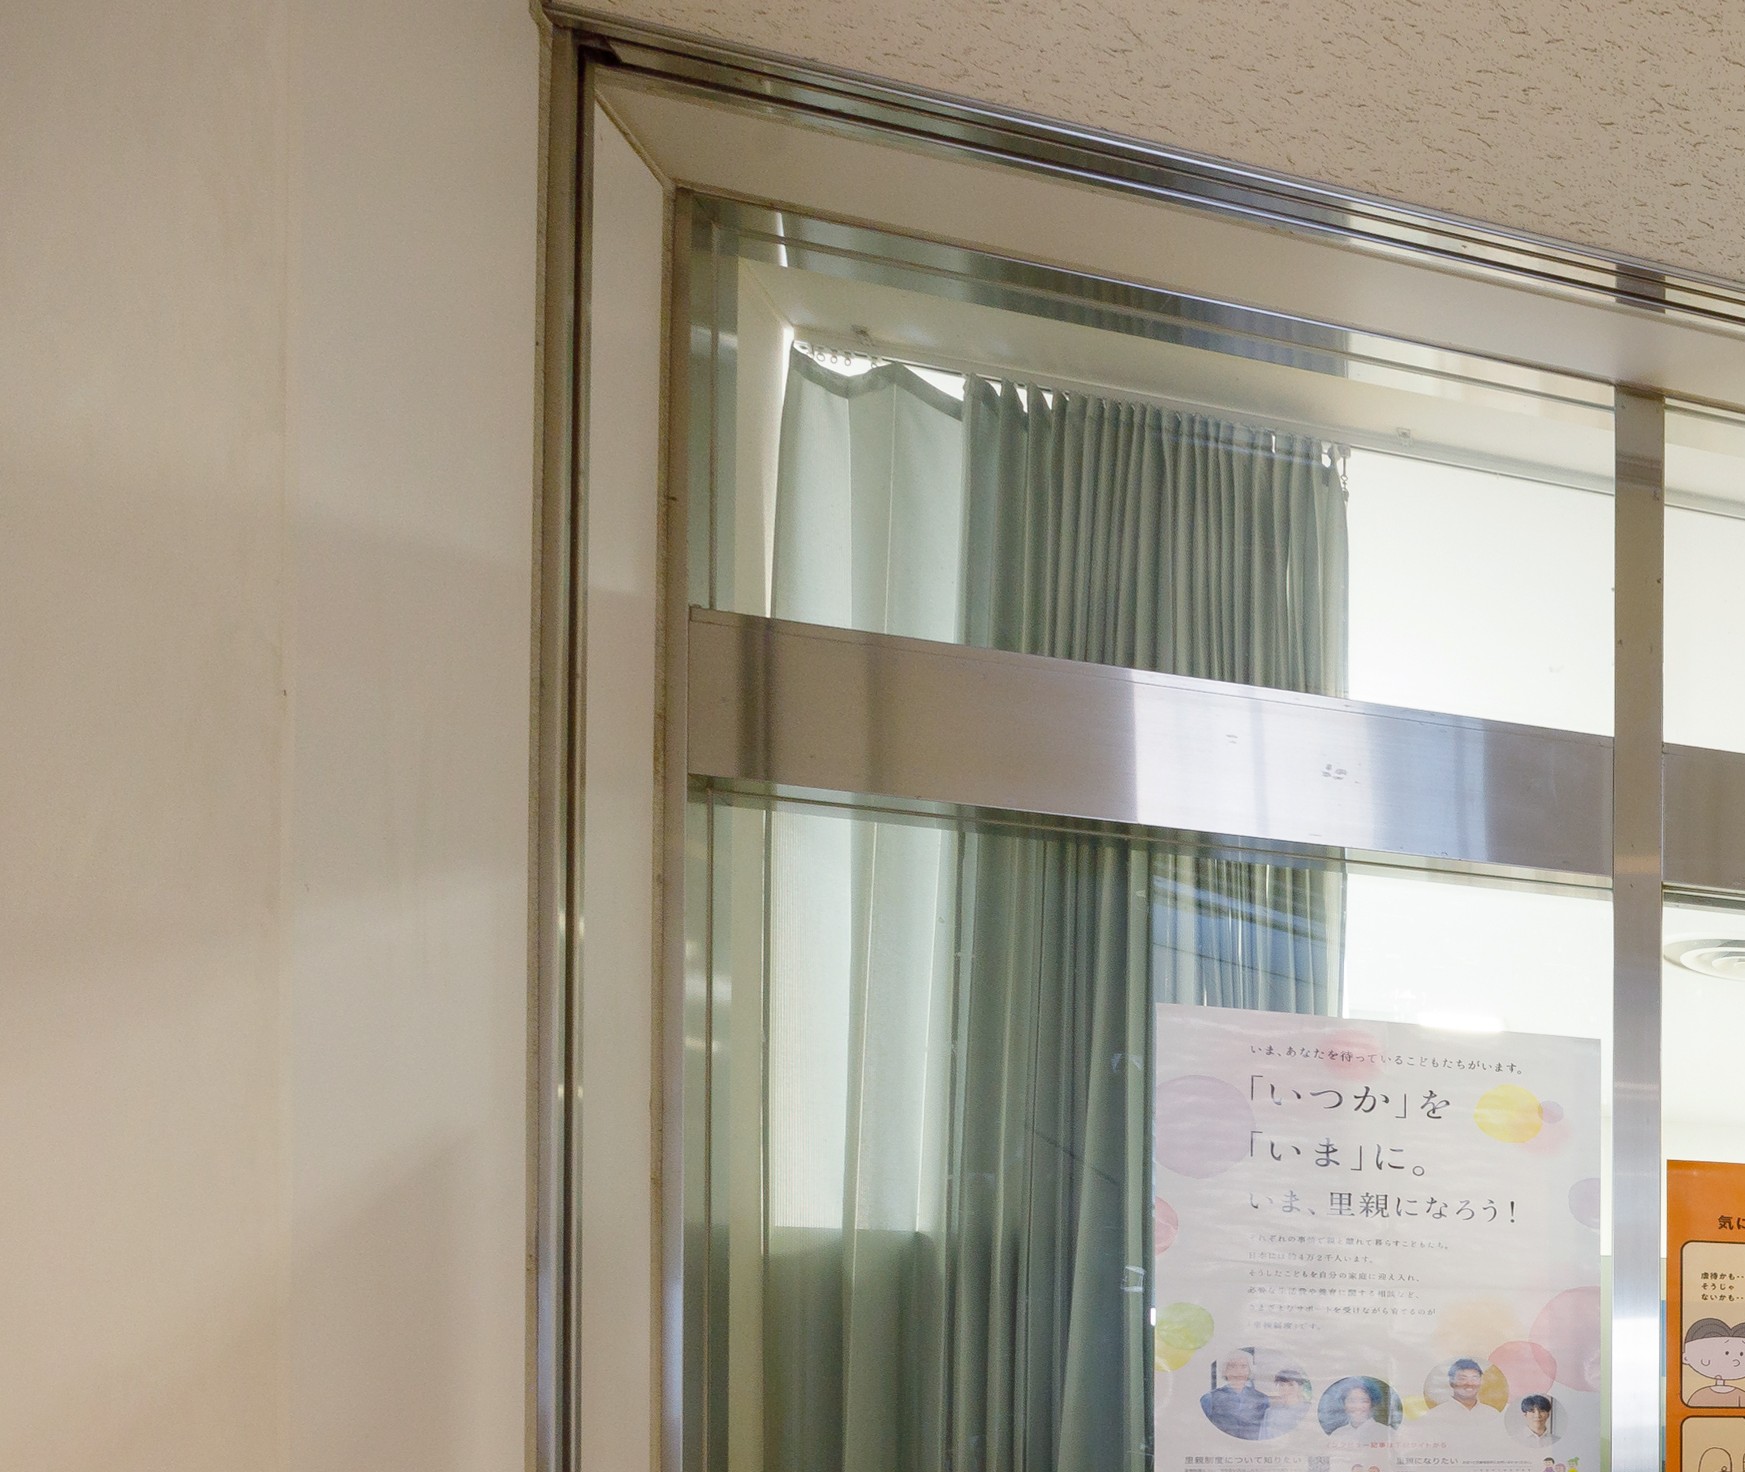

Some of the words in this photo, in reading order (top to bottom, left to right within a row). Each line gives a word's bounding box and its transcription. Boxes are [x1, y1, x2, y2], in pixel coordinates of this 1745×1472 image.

[1250, 1045, 1523, 1076] いま、あなたを待っているこどもたちがいます。
[1250, 1075, 1451, 1119] 「いつか」を
[1250, 1131, 1426, 1177] 「いま」に。
[1250, 1189, 1517, 1224] いま、里親になろう！
